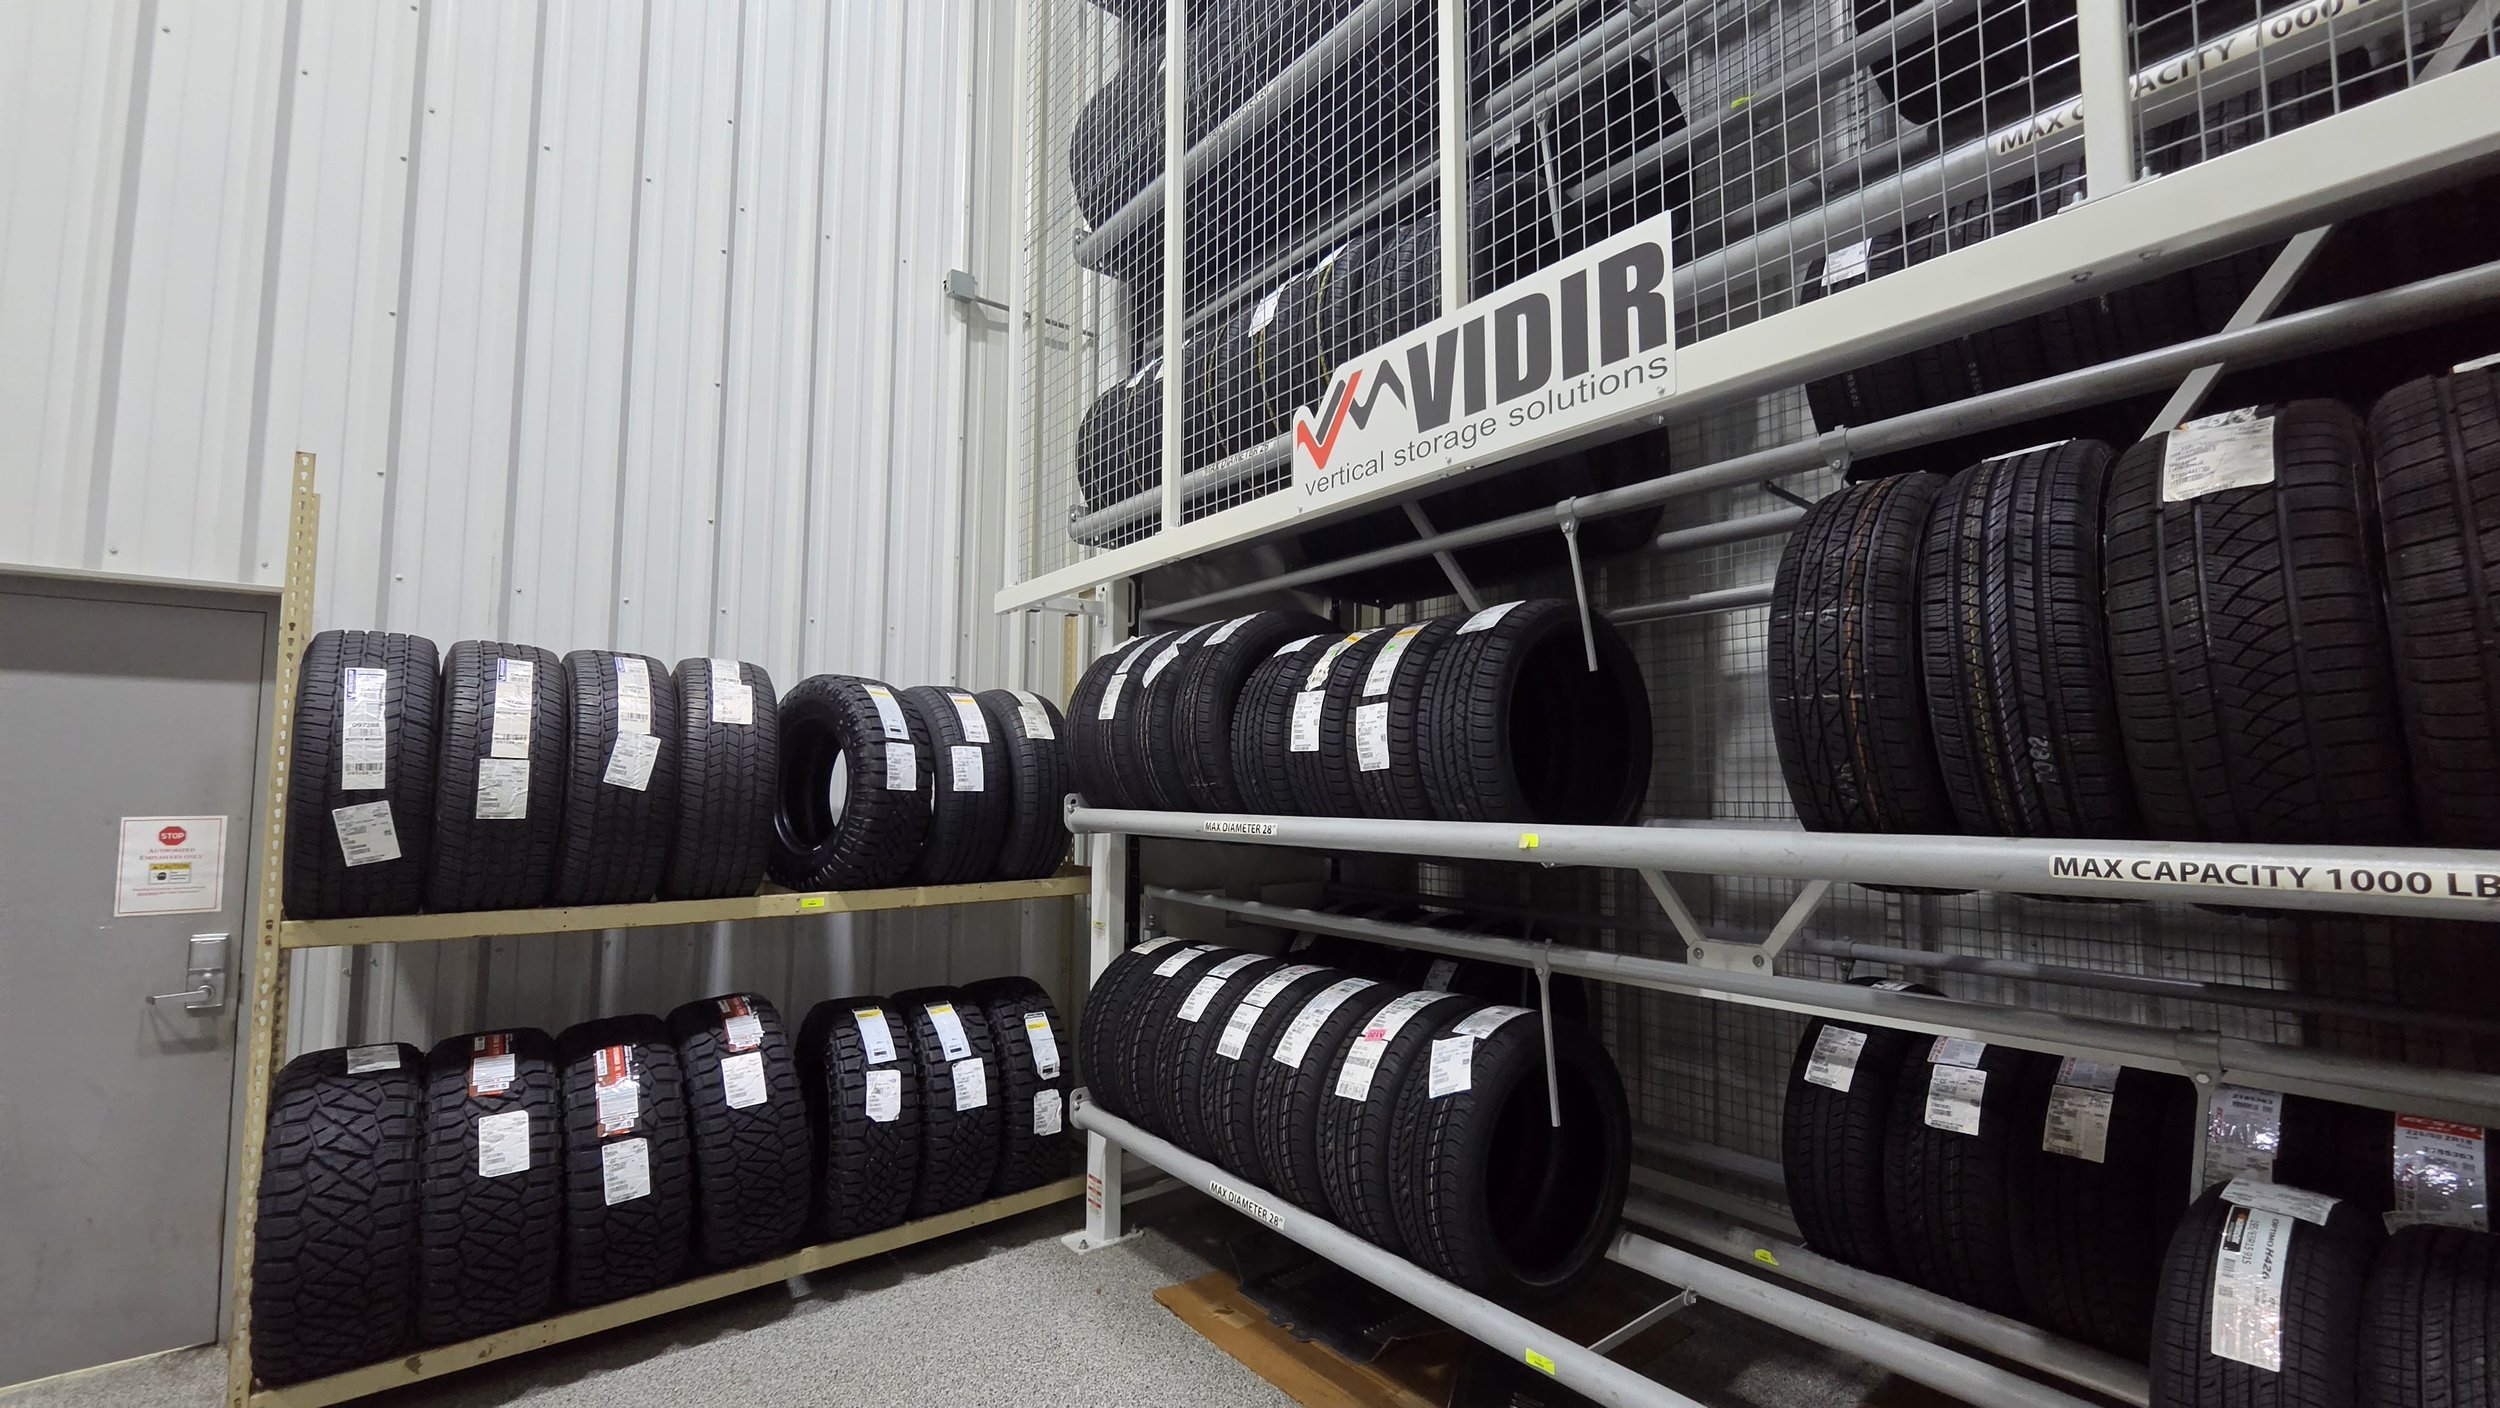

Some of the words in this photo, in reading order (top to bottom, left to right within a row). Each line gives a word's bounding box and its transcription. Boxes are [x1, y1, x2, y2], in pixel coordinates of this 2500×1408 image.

[2000, 111, 2064, 153] MAX
[2071, 38, 2236, 121] CACITY
[1406, 241, 1667, 434] VIDIR
[1305, 450, 1384, 496] vertical
[1394, 417, 1497, 467] storage
[1508, 356, 1668, 427] solutions
[160, 832, 185, 840] STOP
[1205, 822, 1221, 832] MAX
[1222, 822, 1261, 834] DIAMETER
[1262, 824, 1277, 835] 28"
[2052, 856, 2123, 879] MAX
[2131, 859, 2313, 889] CAPACITY
[2326, 868, 2433, 896] 1000
[1211, 1182, 1228, 1199] MAX
[1228, 1191, 1268, 1220] DIAMETER
[1269, 1213, 1283, 1227] 28"
[2266, 1218, 2280, 1248] OPTIMO
[2261, 1247, 2275, 1280] H426
